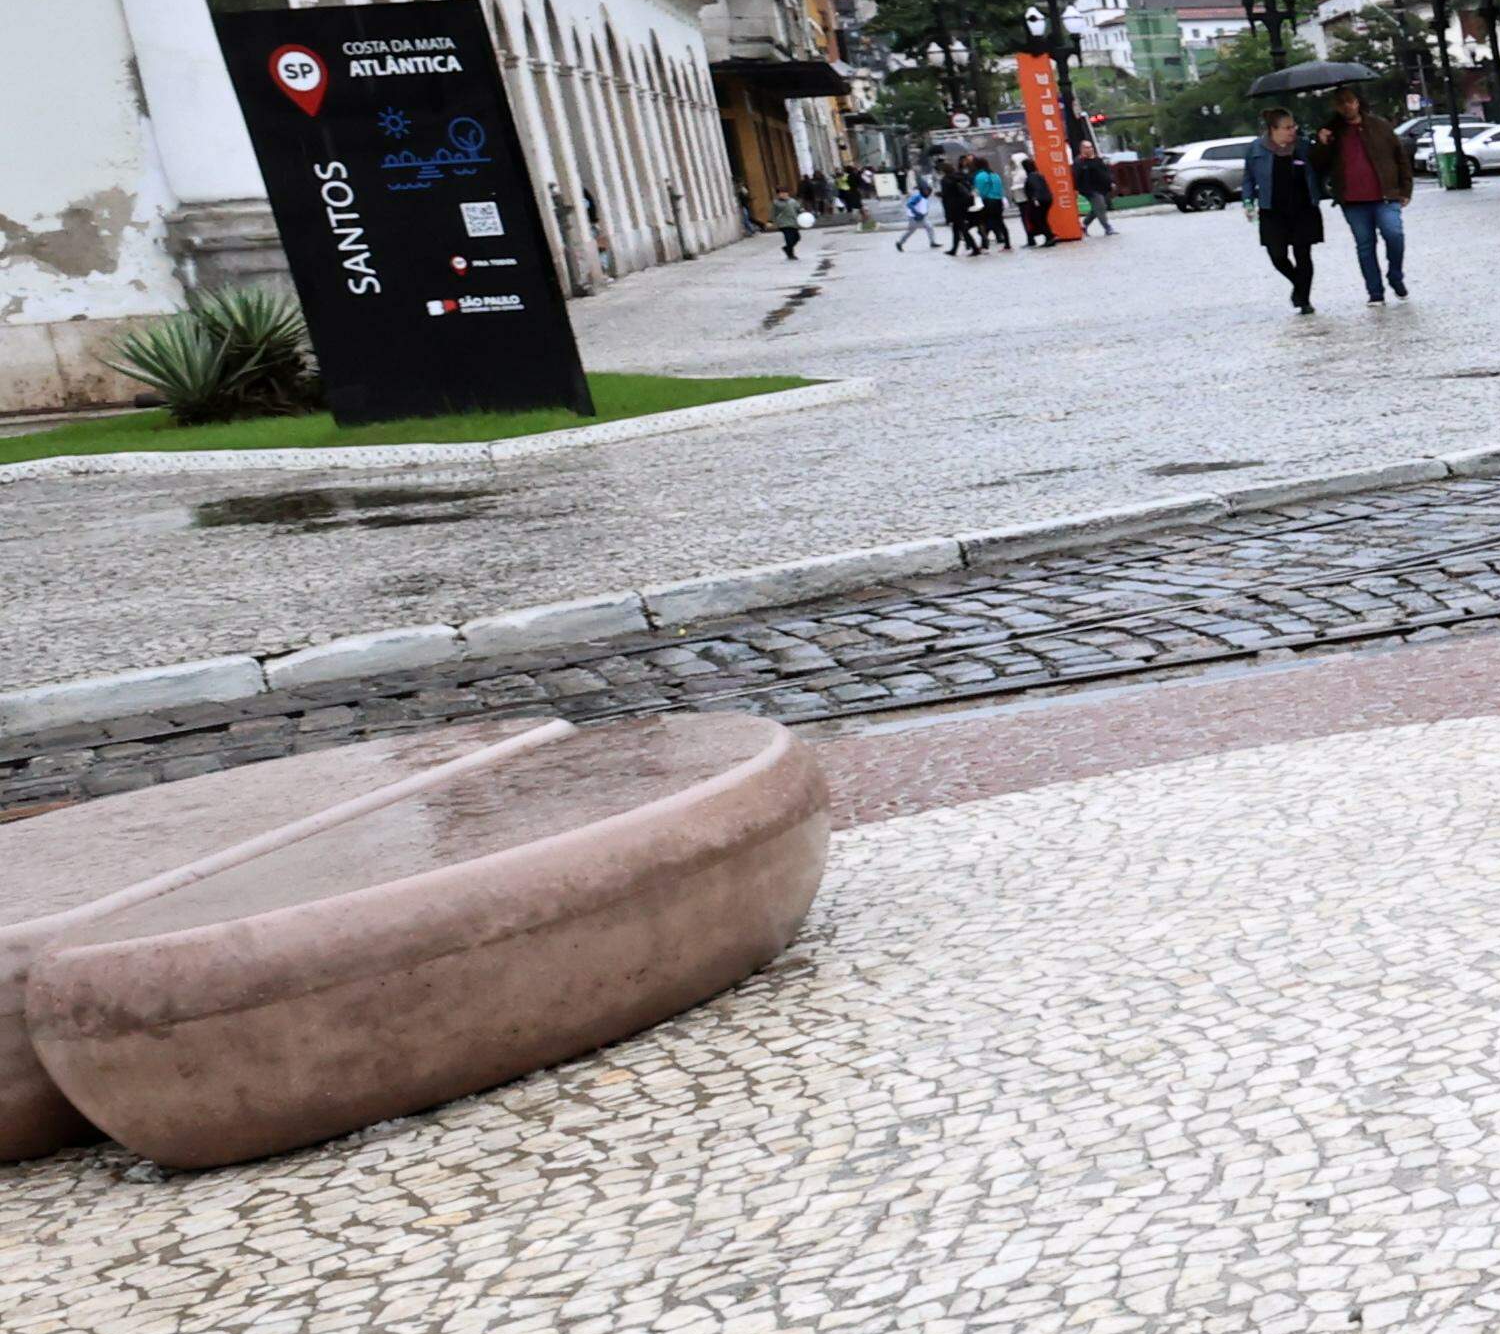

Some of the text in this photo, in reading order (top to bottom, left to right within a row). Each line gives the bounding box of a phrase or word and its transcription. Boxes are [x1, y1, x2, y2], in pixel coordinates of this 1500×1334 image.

[342, 37, 456, 55] COSTA DA MATA
[284, 63, 314, 79] SP
[350, 55, 464, 77] ATLÂNTICA
[314, 161, 381, 294] SANTOS
